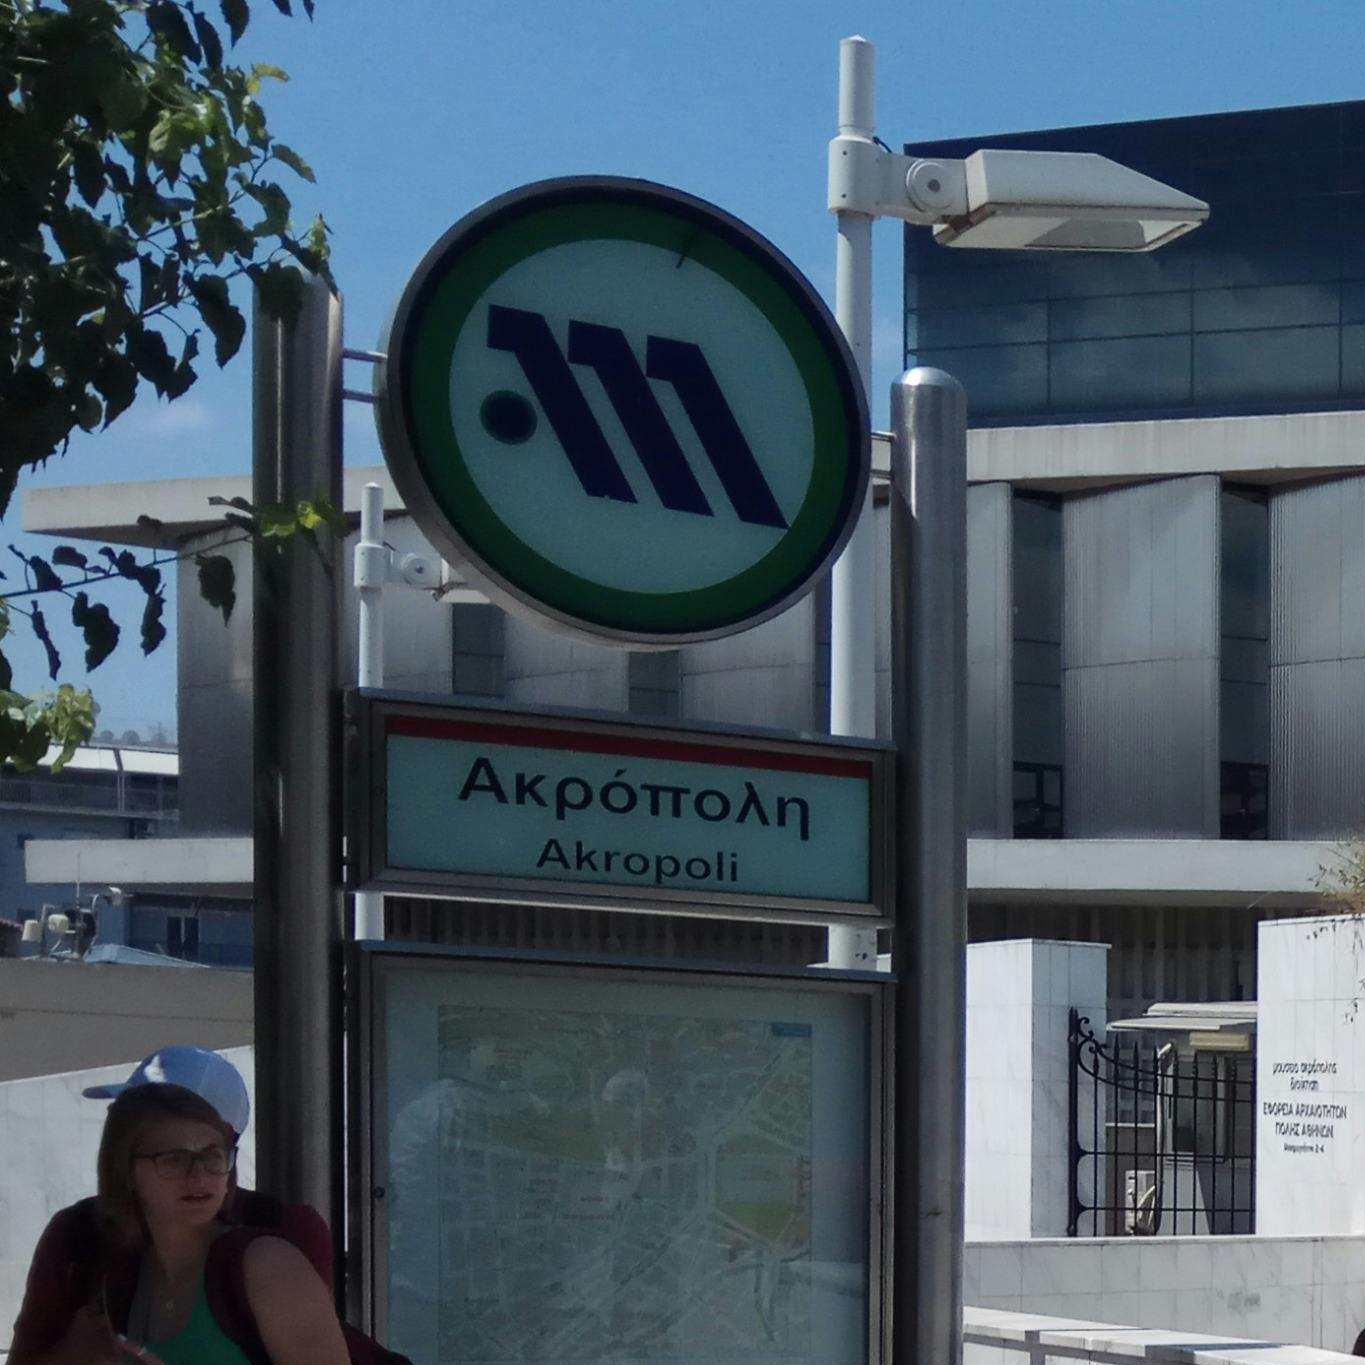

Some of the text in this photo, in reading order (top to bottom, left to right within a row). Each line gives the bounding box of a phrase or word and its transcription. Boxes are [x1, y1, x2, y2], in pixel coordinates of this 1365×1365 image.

[458, 757, 810, 841] Ακρόπολη
[537, 839, 740, 884] Akropoli
[1263, 1102, 1347, 1119] ΕΦΟΡΕΙΑ ΑΡΧΑΙΟΤΗΤΩΝ
[1275, 1122, 1334, 1138] ΠΟΛΗΣ ΑΘΗΝΩΝ
